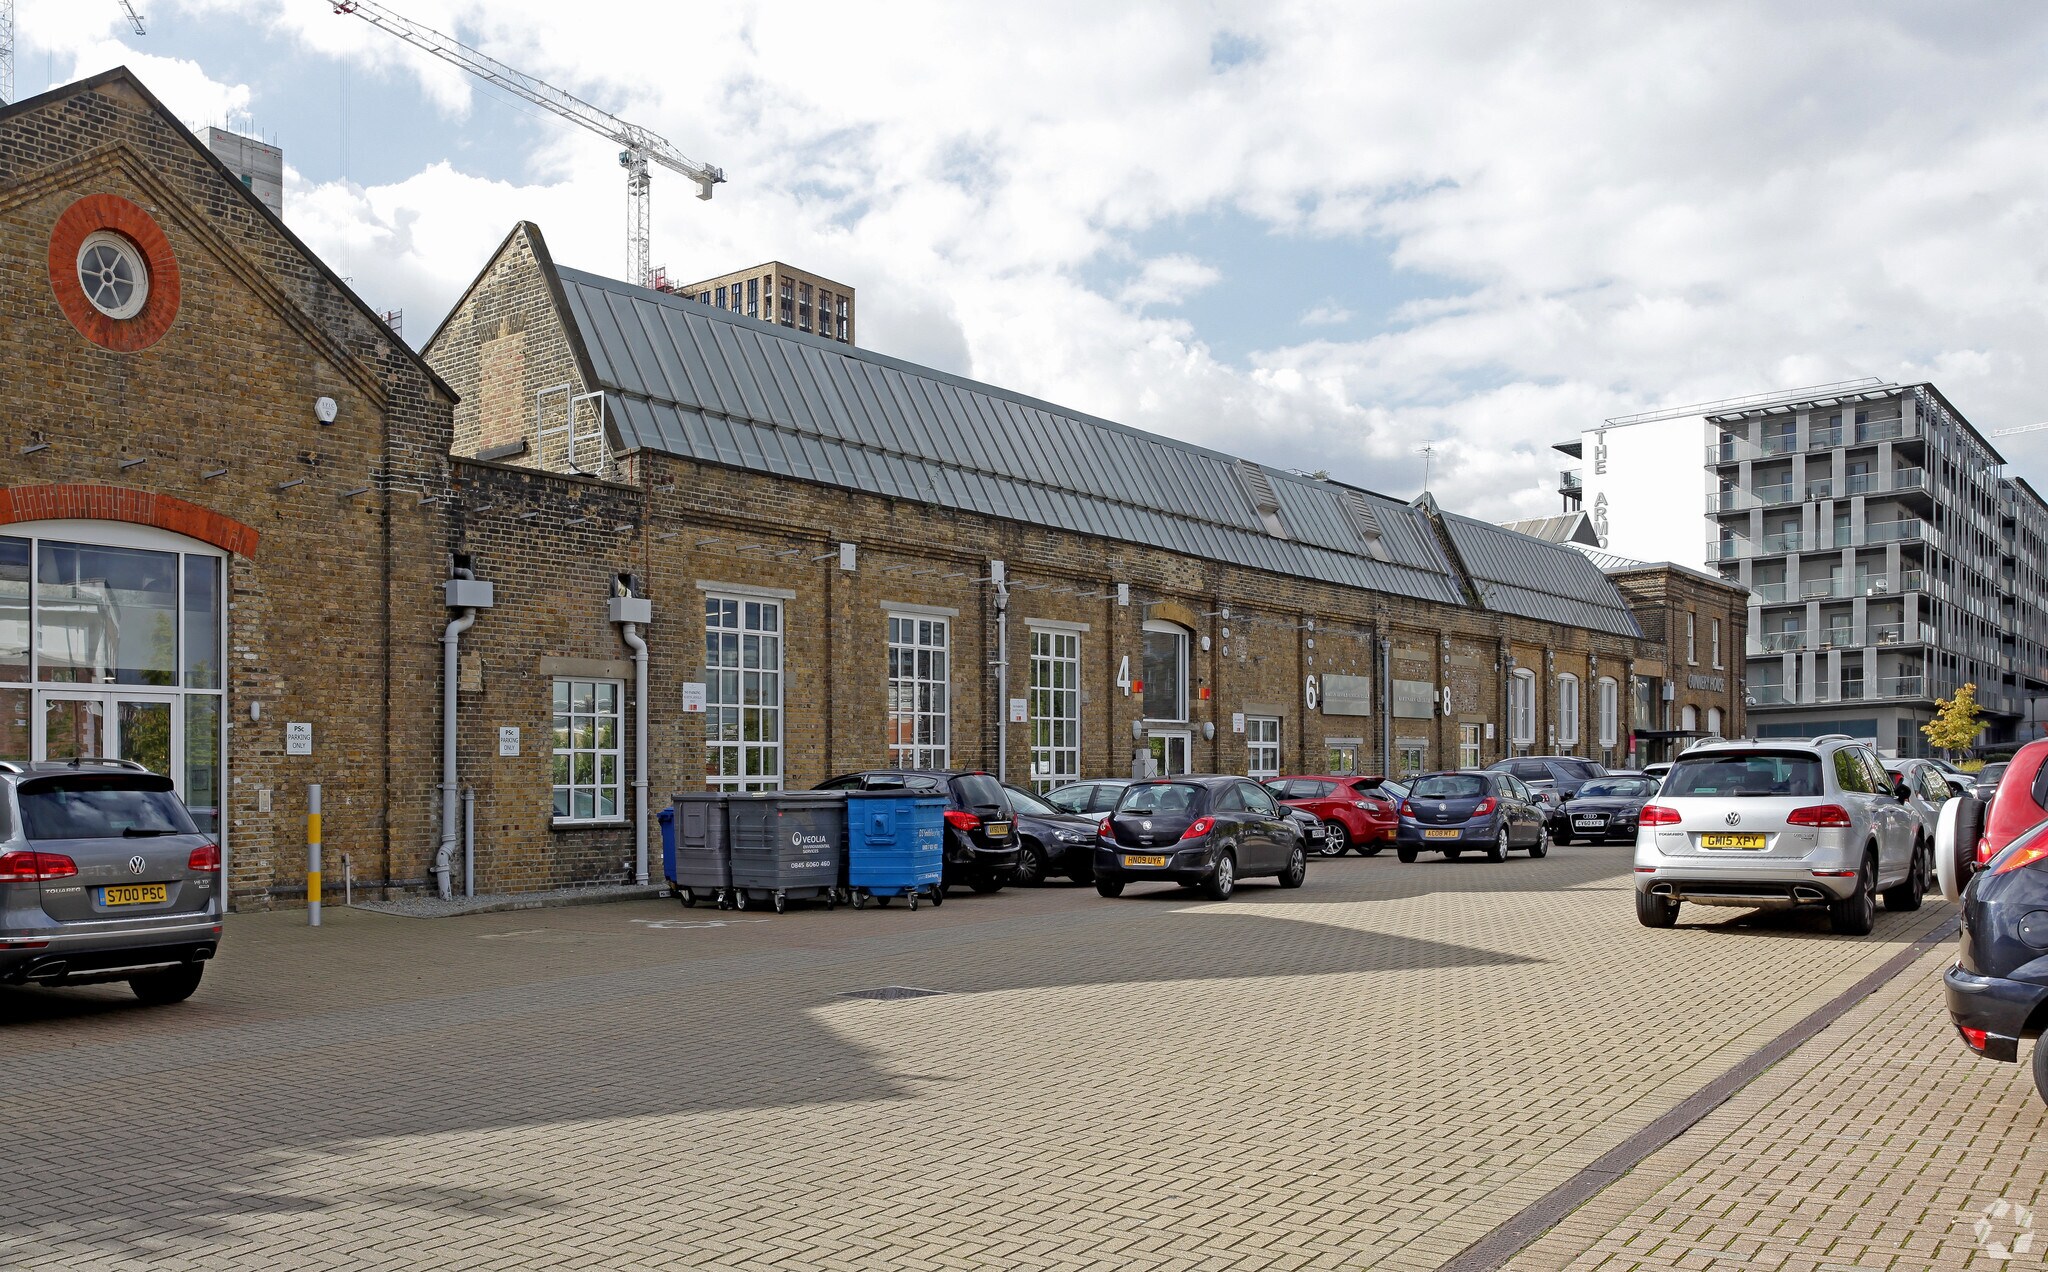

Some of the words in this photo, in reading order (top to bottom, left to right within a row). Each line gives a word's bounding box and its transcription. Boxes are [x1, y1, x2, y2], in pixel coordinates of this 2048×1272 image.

[1594, 429, 1608, 475] THE
[1594, 492, 1608, 549] ARMO
[1117, 656, 1130, 696] 4
[1306, 674, 1316, 710] 6
[1443, 685, 1451, 717] 8
[1708, 835, 1733, 846] GM15
[1736, 835, 1758, 846] XPY
[1128, 856, 1146, 864] HN09
[1147, 856, 1161, 864] UYR
[107, 888, 139, 903] S700
[142, 886, 164, 900] PSC
